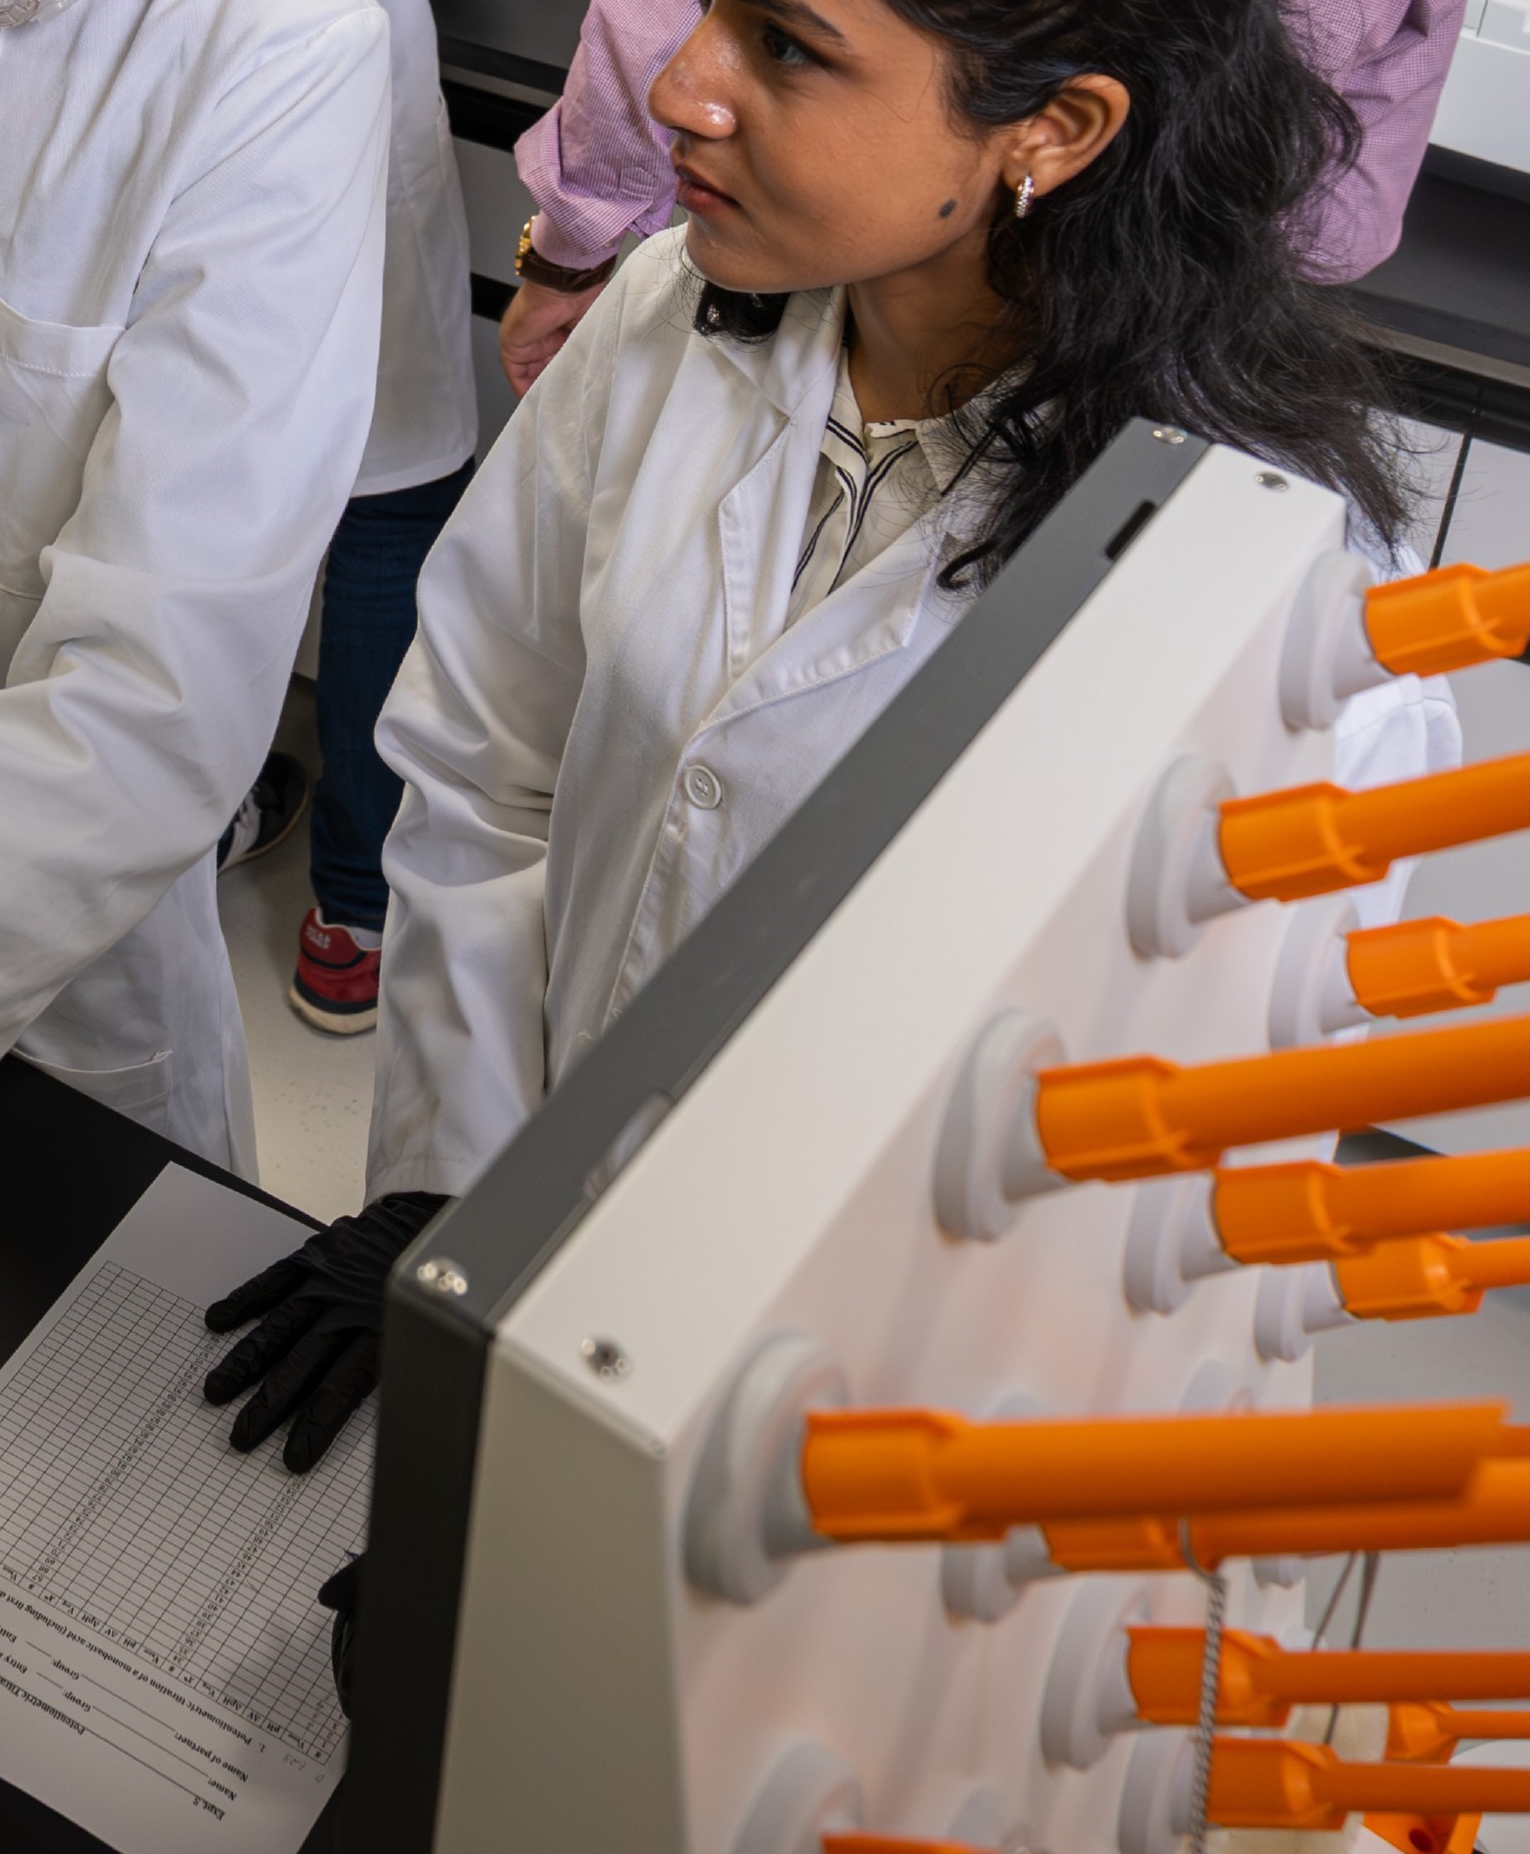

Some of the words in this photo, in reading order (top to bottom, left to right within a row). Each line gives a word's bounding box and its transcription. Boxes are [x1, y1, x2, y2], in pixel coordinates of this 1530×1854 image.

[5, 1594, 25, 1611] first
[24, 1604, 68, 1636] (including
[65, 1630, 87, 1646] acid
[3, 1655, 28, 1675] Entry
[85, 1642, 133, 1673] monobasic
[51, 1658, 80, 1681] Group:
[136, 1672, 149, 1683] of
[62, 1691, 92, 1713] Group:
[149, 1678, 186, 1706] titration
[20, 1689, 87, 1736] Potentiometric
[186, 1701, 254, 1747] Potentiometric
[174, 1731, 213, 1760] partner:
[209, 1754, 222, 1765] of
[221, 1761, 249, 1783] Name
[207, 1778, 238, 1802] Name:
